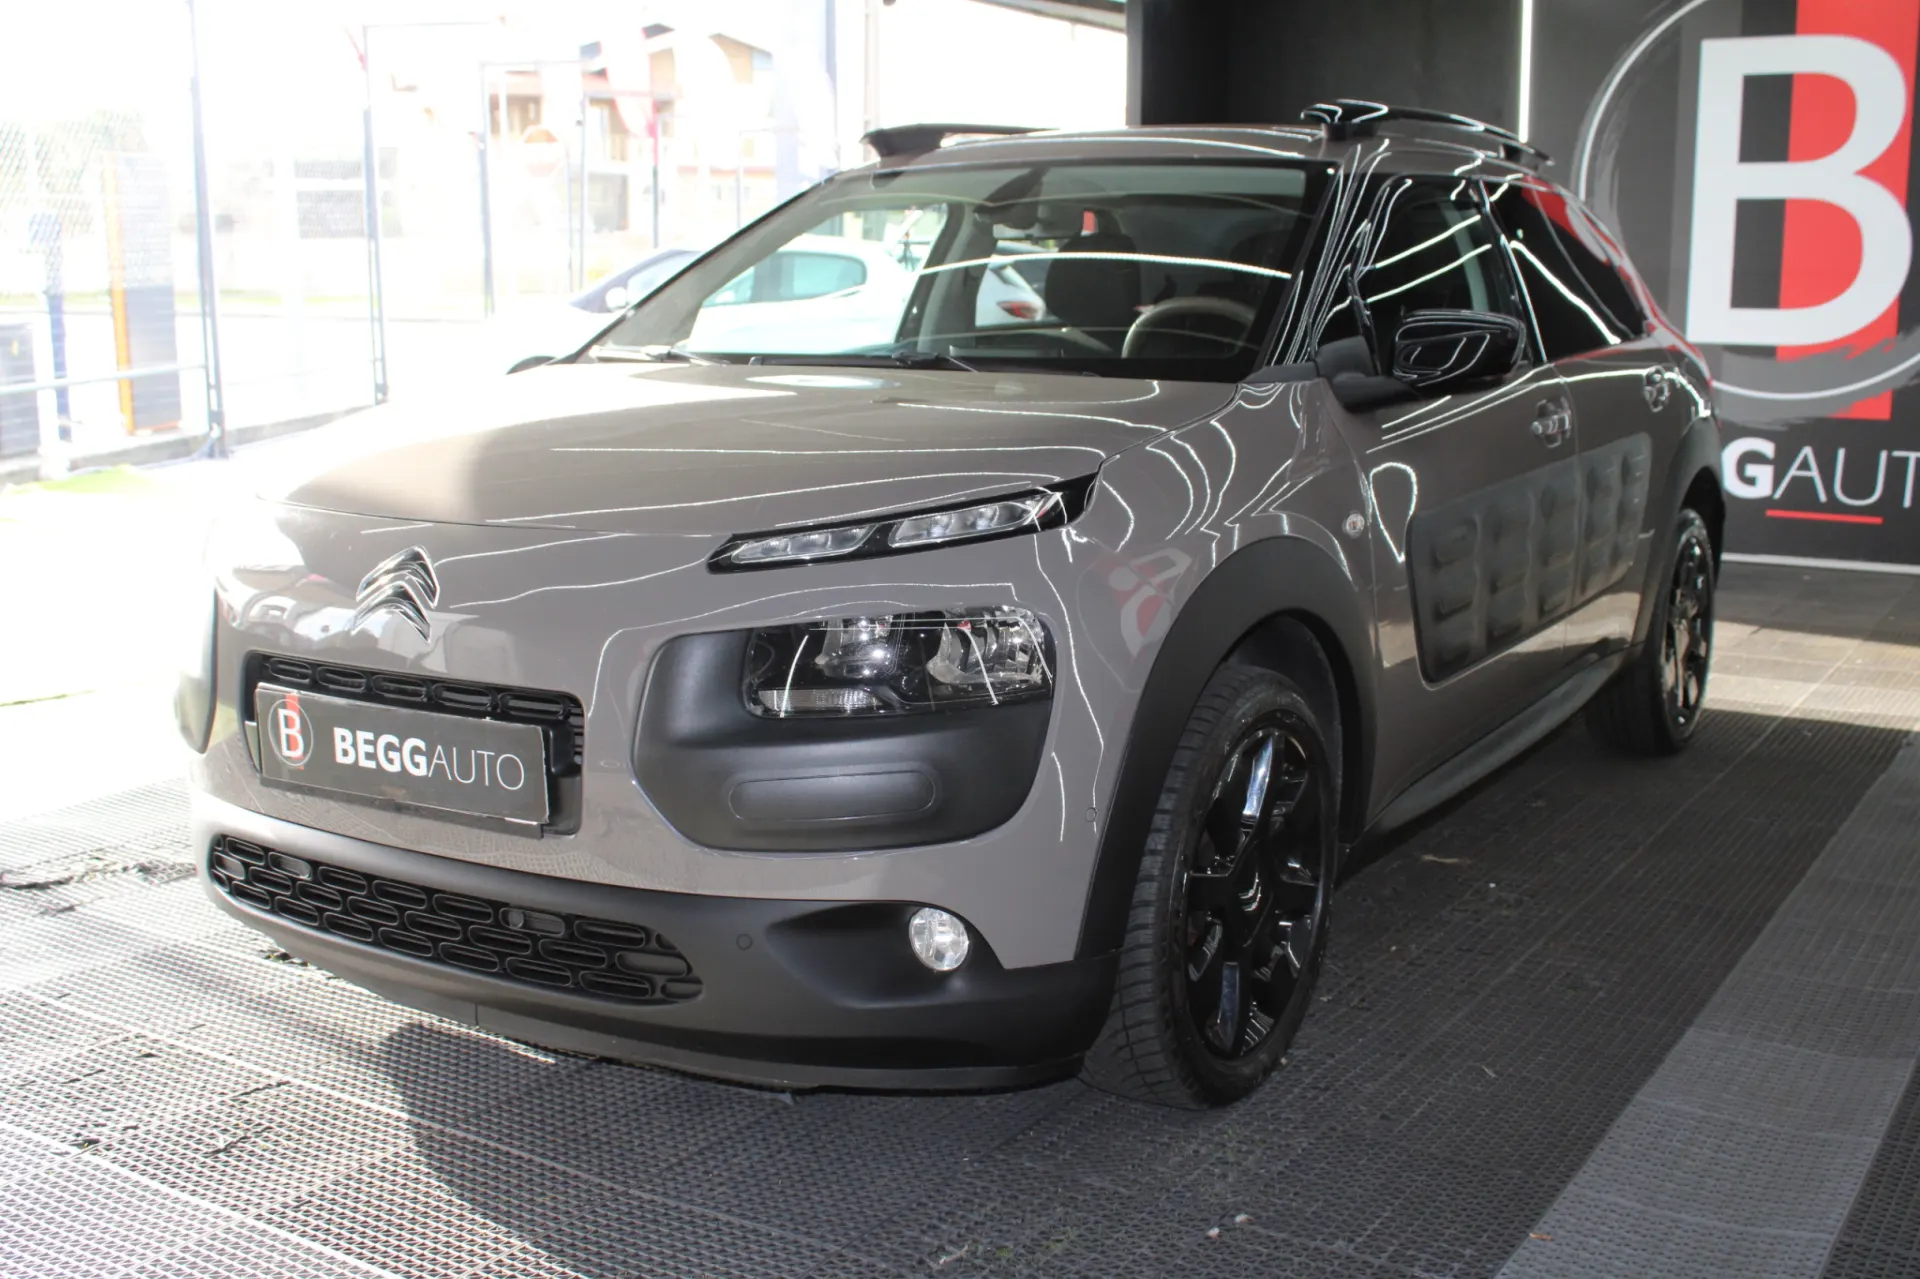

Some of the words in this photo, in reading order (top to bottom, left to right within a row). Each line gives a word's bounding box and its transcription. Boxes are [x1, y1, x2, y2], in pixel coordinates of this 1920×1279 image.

[1686, 34, 1913, 346] B
[277, 707, 304, 758] B
[333, 727, 525, 790] BEGGAUTO
